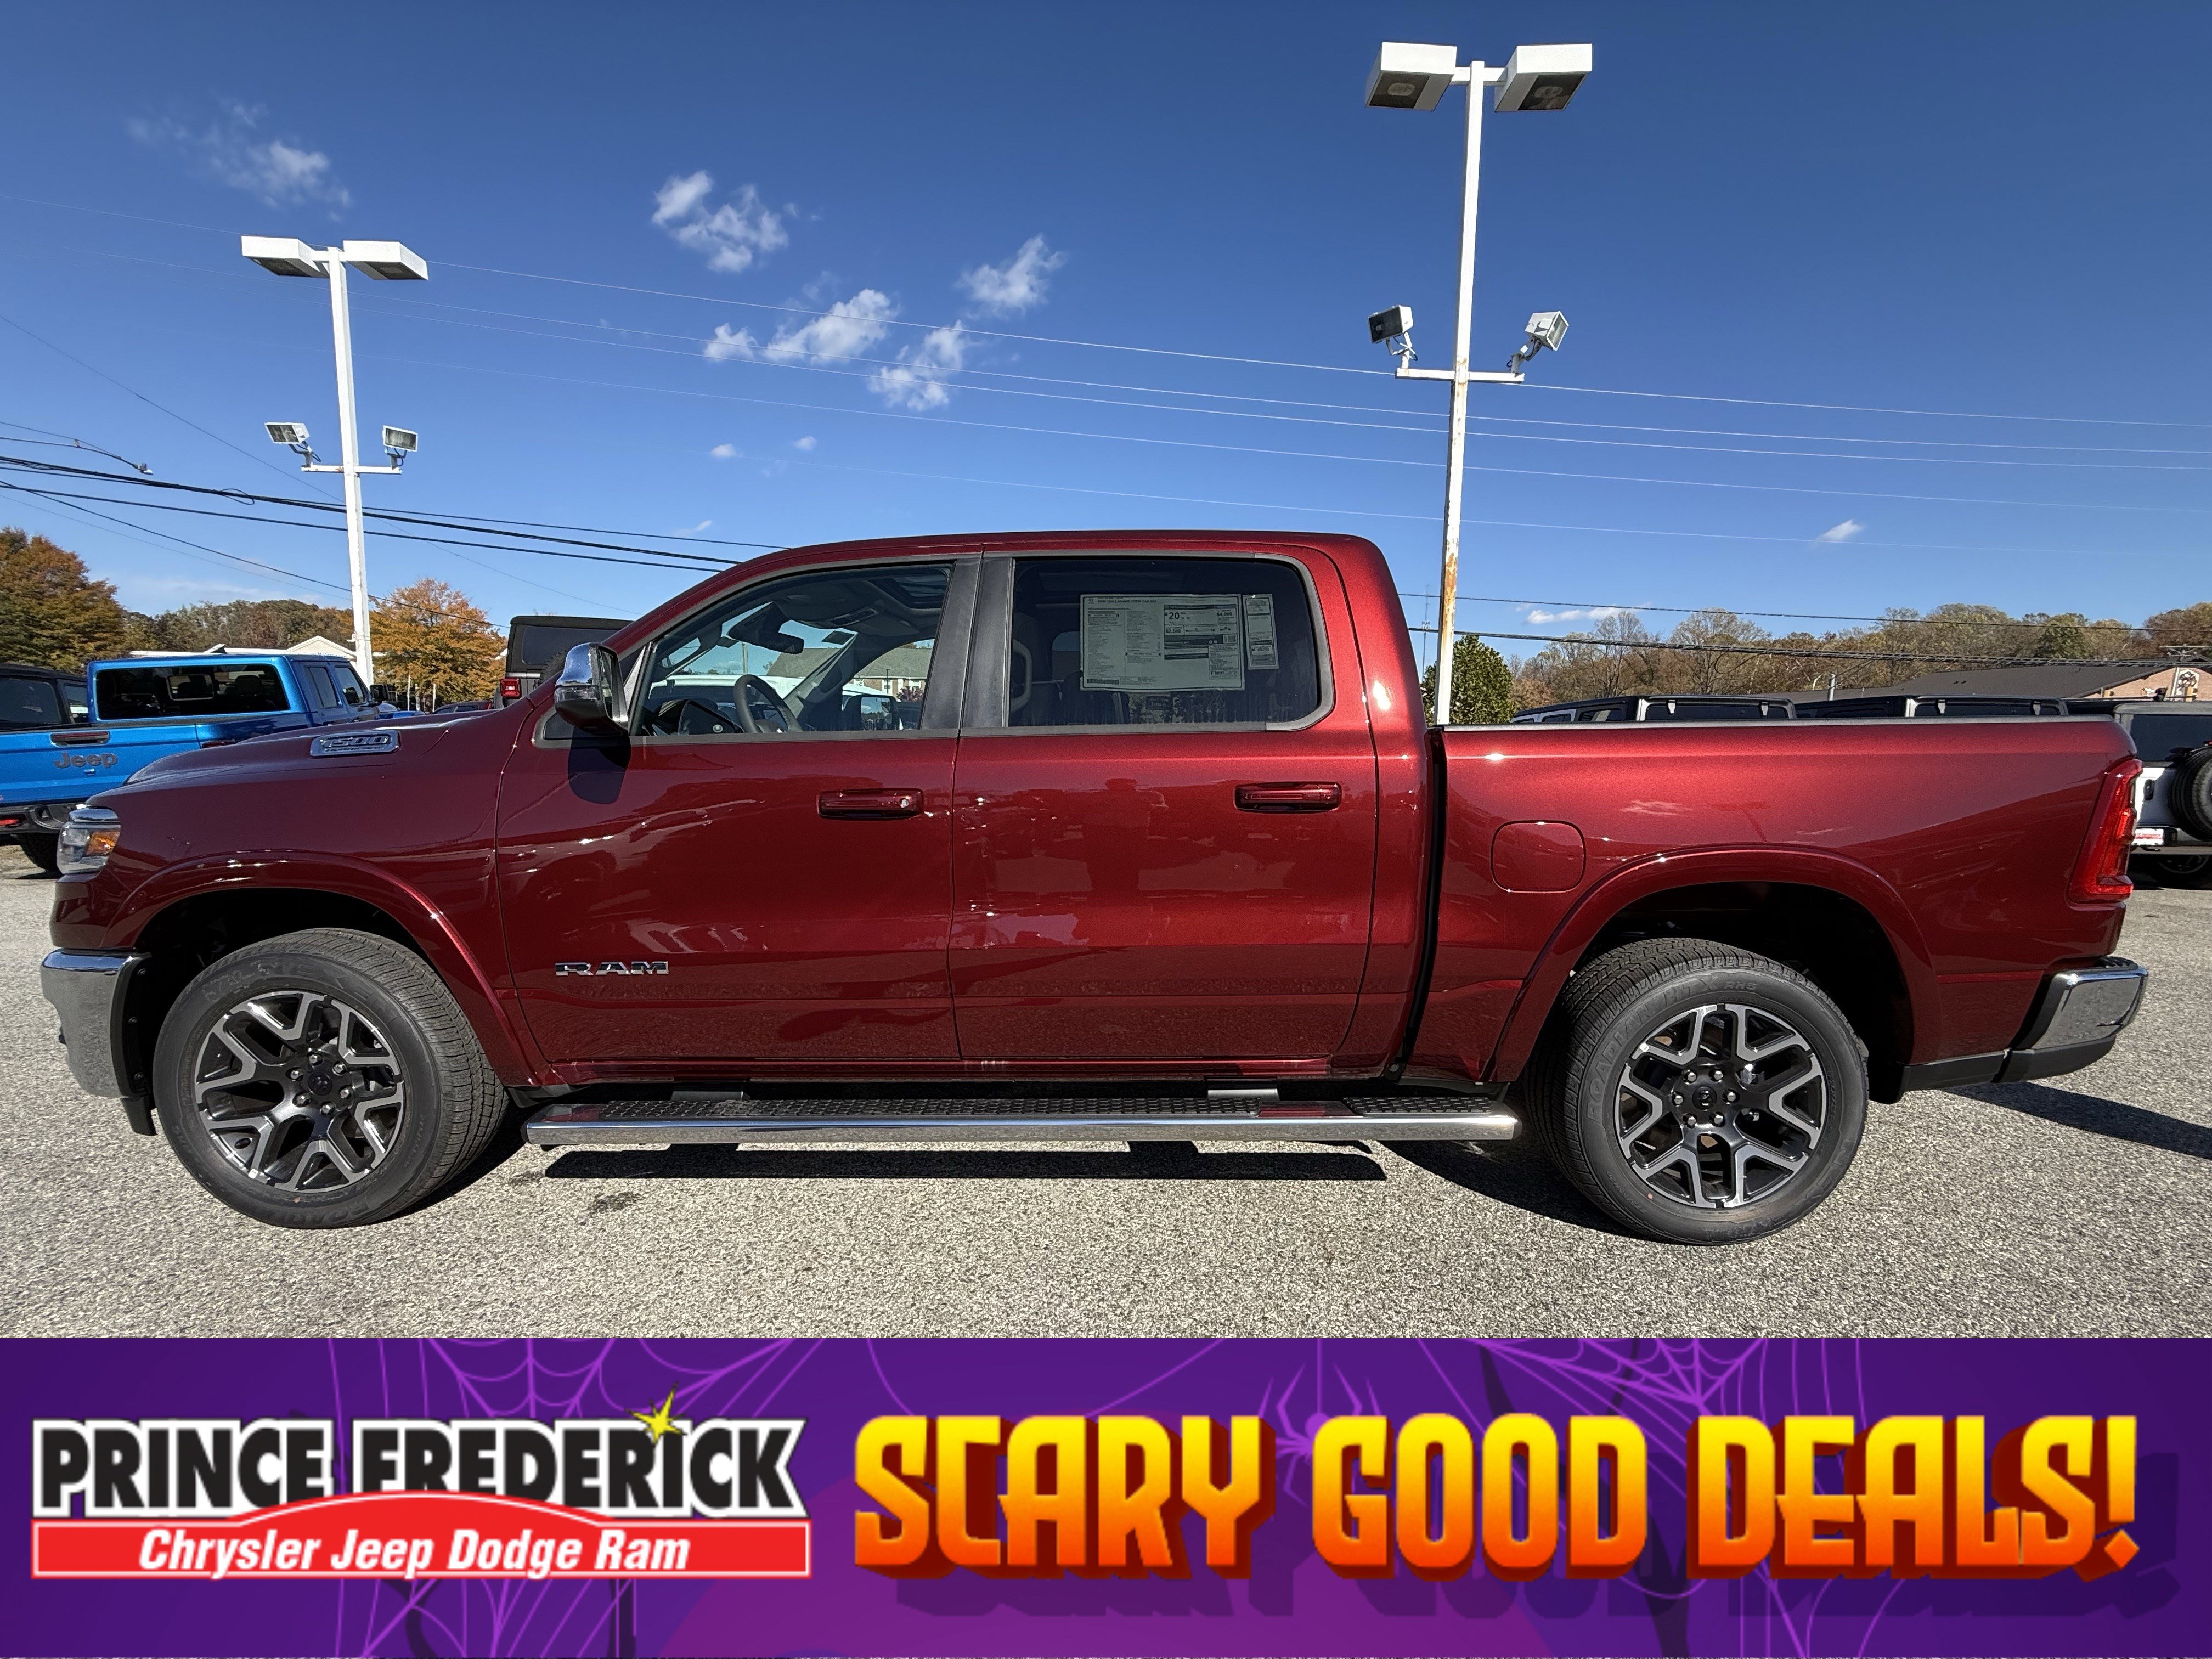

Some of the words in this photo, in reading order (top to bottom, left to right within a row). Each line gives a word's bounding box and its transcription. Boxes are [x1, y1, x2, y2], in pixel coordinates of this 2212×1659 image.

[54, 752, 118, 769] Jeep
[555, 961, 670, 976] RAM
[1587, 1002, 1656, 1124] ROADIAN
[1724, 981, 1757, 991] RH5
